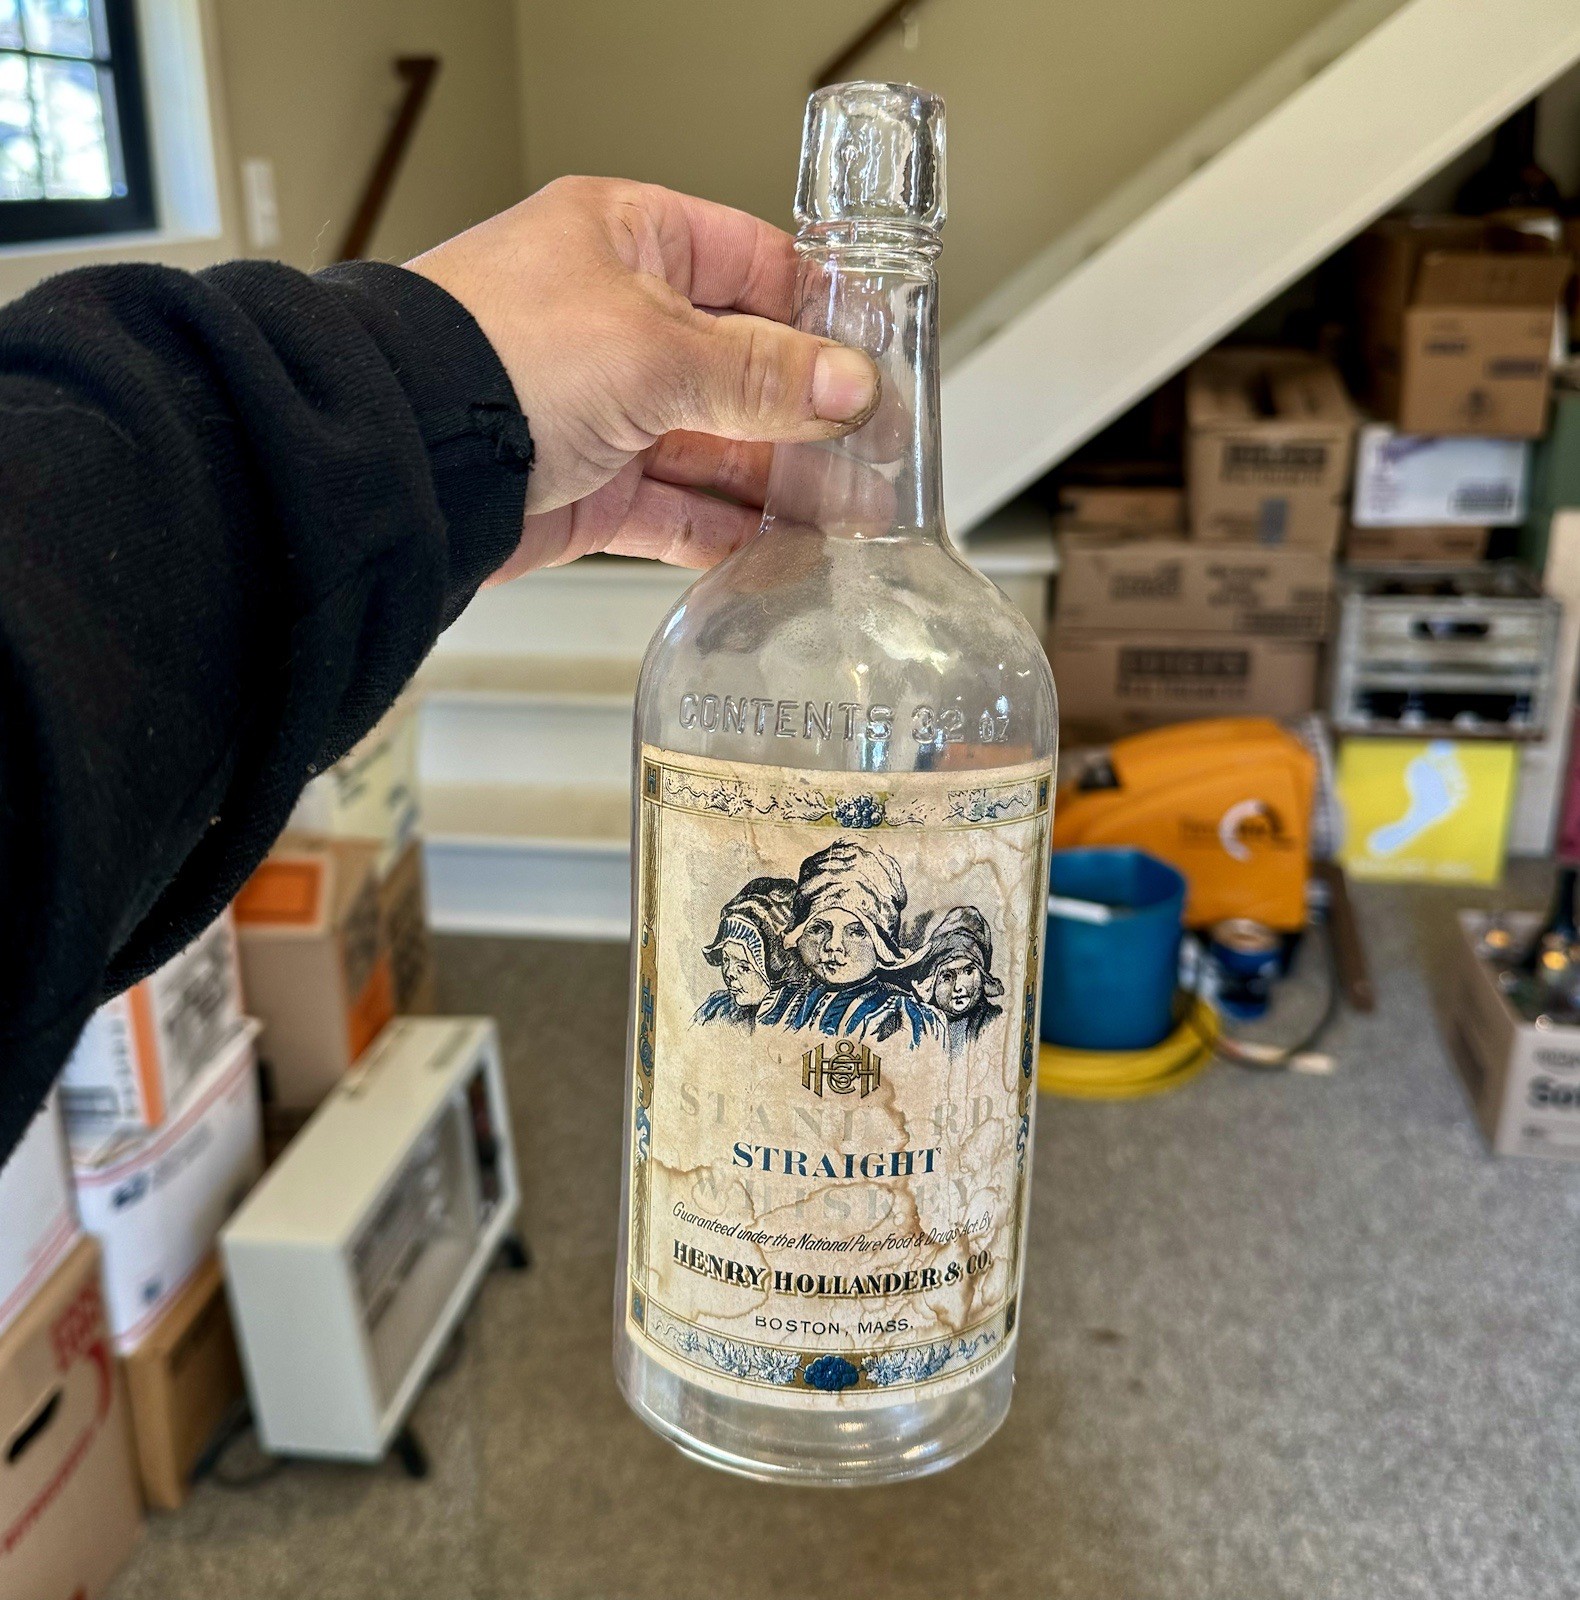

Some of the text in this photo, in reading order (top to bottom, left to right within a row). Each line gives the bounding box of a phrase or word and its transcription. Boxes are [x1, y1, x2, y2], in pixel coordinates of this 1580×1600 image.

[679, 693, 894, 742] CONTENTS
[911, 704, 966, 744] 32
[732, 1141, 942, 1179] STRAIGHT
[672, 1201, 742, 1238] Guaranteed
[736, 1228, 774, 1246] under
[771, 1229, 796, 1249] the
[795, 1233, 855, 1252] National
[851, 1233, 882, 1252] Pure
[879, 1232, 915, 1251] Food
[913, 1231, 924, 1248] &
[924, 1226, 961, 1245] Drugs
[978, 1209, 994, 1231] By
[673, 1239, 994, 1297] HENRY HOLLANDER & CO.
[755, 1314, 915, 1337] BOSTON, MASS.
